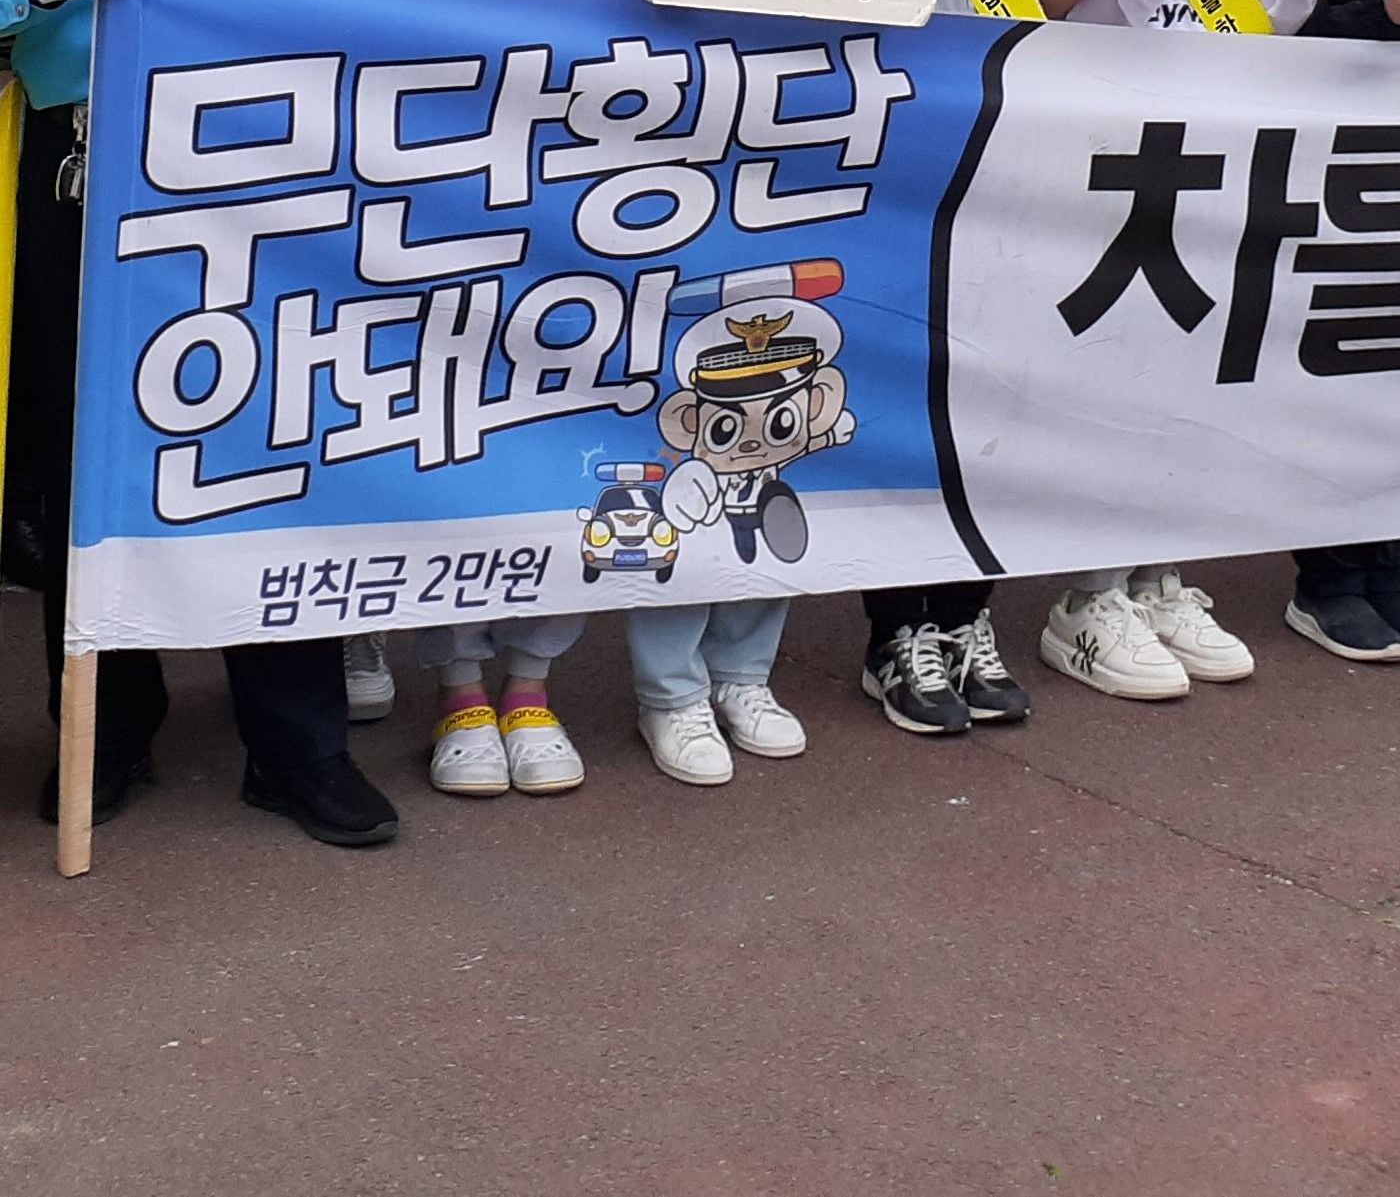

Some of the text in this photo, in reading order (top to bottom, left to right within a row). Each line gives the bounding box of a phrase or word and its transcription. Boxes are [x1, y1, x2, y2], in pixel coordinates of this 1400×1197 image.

[116, 36, 916, 313] 무단횡단
[134, 264, 680, 525] 안돼요!
[259, 543, 553, 628] 범칙금 2만원
